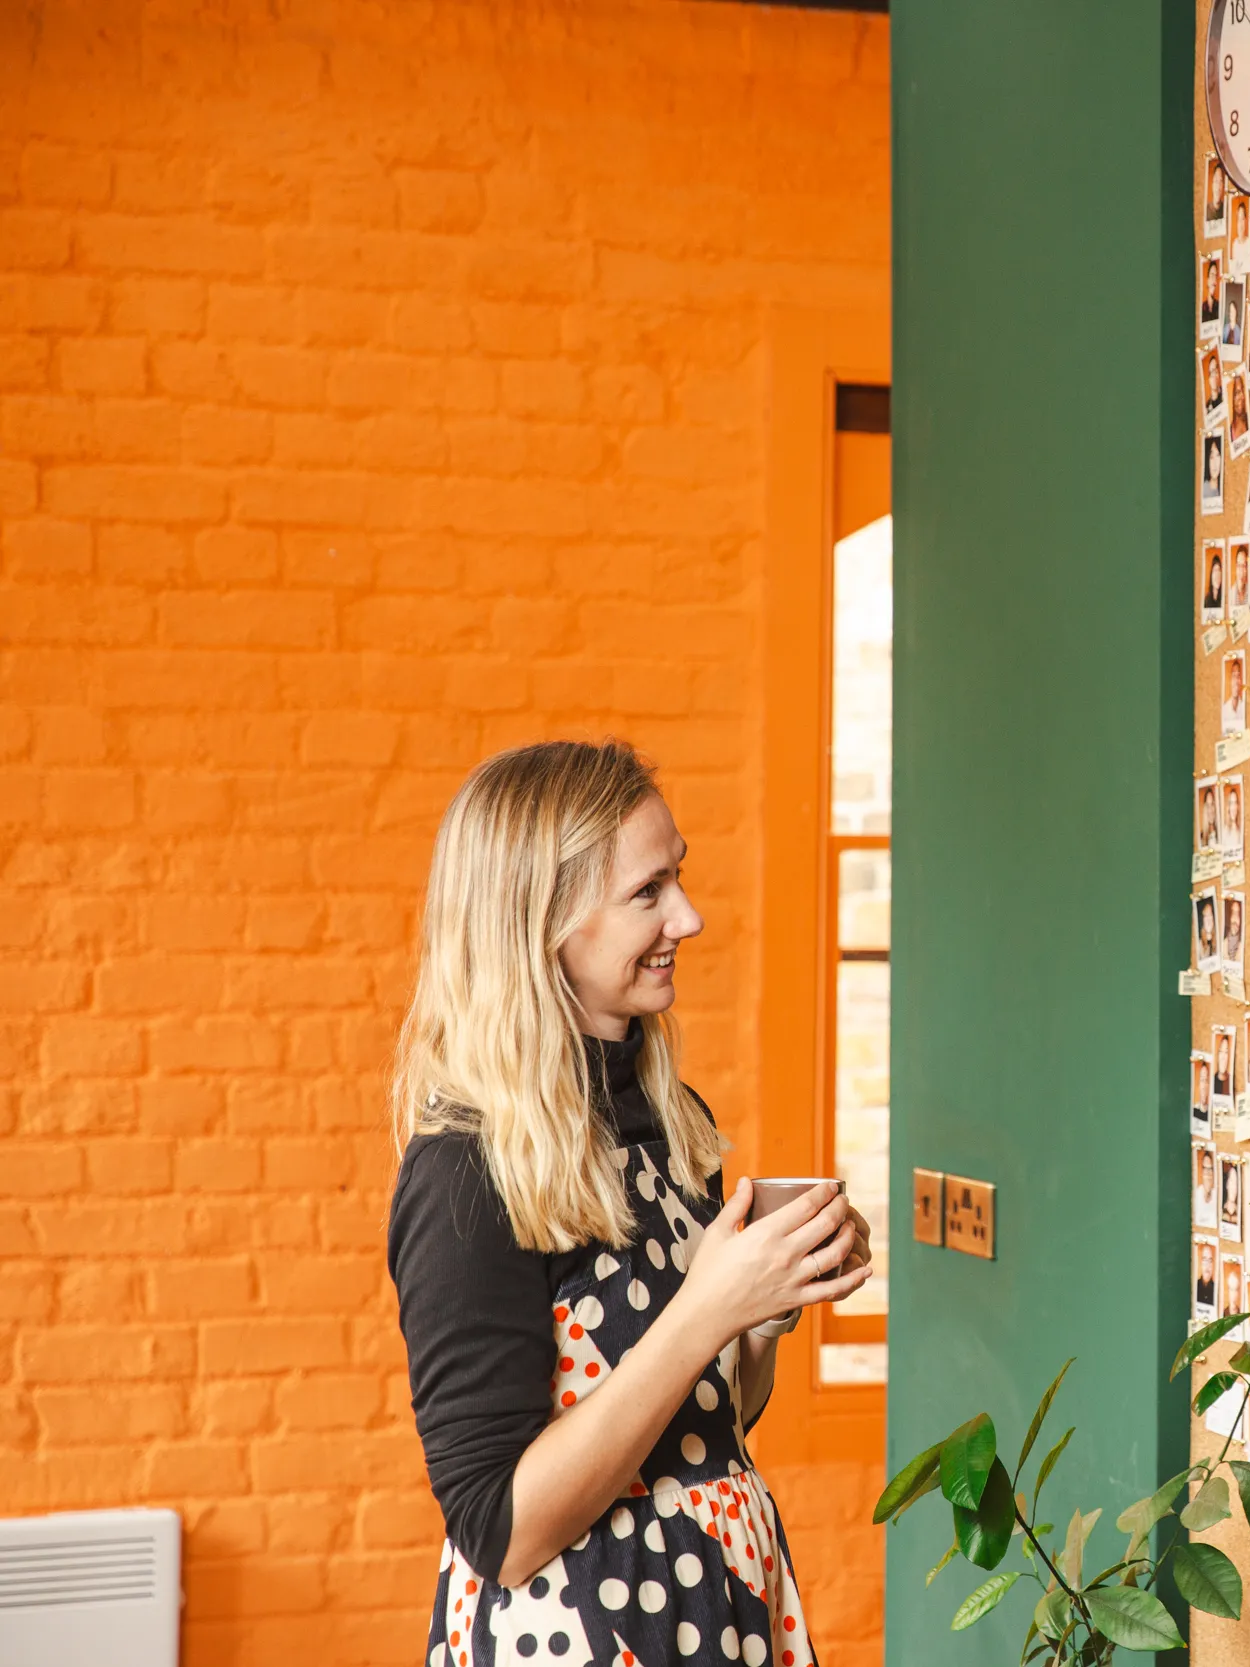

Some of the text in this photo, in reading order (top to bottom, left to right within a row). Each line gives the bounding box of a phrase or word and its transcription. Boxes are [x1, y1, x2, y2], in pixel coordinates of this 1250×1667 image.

[1230, 0, 1246, 25] 10
[1223, 54, 1233, 81] 9
[1229, 109, 1239, 137] 8
